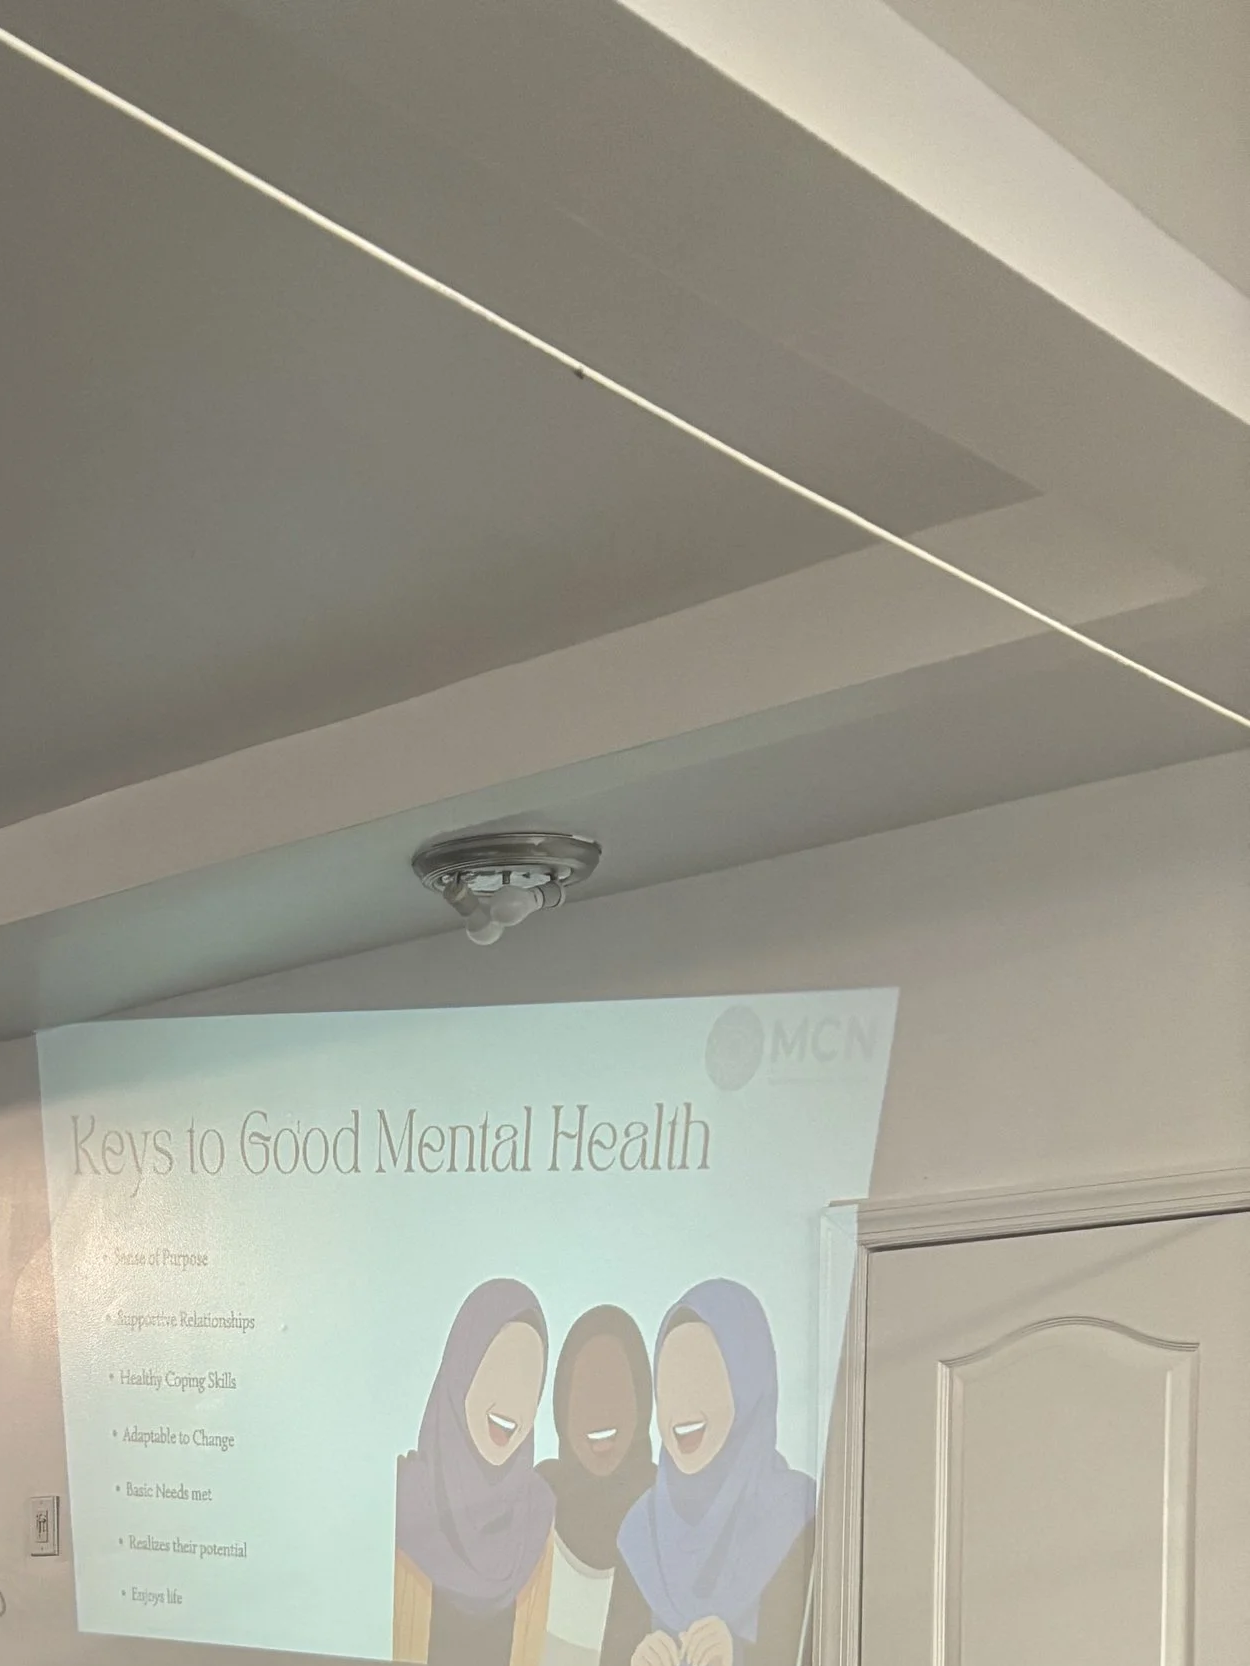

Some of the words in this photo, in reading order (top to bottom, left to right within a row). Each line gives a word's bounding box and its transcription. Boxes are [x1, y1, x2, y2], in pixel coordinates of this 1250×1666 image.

[770, 1014, 880, 1064] MCN
[70, 1113, 175, 1198] Keys
[187, 1116, 226, 1175] to
[240, 1109, 362, 1176] Good
[375, 1104, 533, 1174] Mental
[547, 1101, 711, 1173] Health
[149, 1249, 161, 1266] of
[162, 1249, 209, 1272] Purpose
[116, 1308, 177, 1331] Supportive
[179, 1310, 256, 1334] Relationships
[119, 1368, 163, 1391] Healthy
[165, 1370, 207, 1394] Coping
[207, 1371, 237, 1390] Skills
[122, 1425, 177, 1448] Adaptable
[178, 1431, 191, 1445] to
[192, 1428, 236, 1452] Change
[126, 1481, 154, 1498] Basic
[155, 1483, 190, 1501] Needs
[191, 1488, 213, 1502] met
[128, 1534, 171, 1552] Realizes
[172, 1537, 198, 1555] their
[199, 1541, 248, 1560] potential
[131, 1586, 165, 1607] Enjoys
[167, 1587, 183, 1605] life
